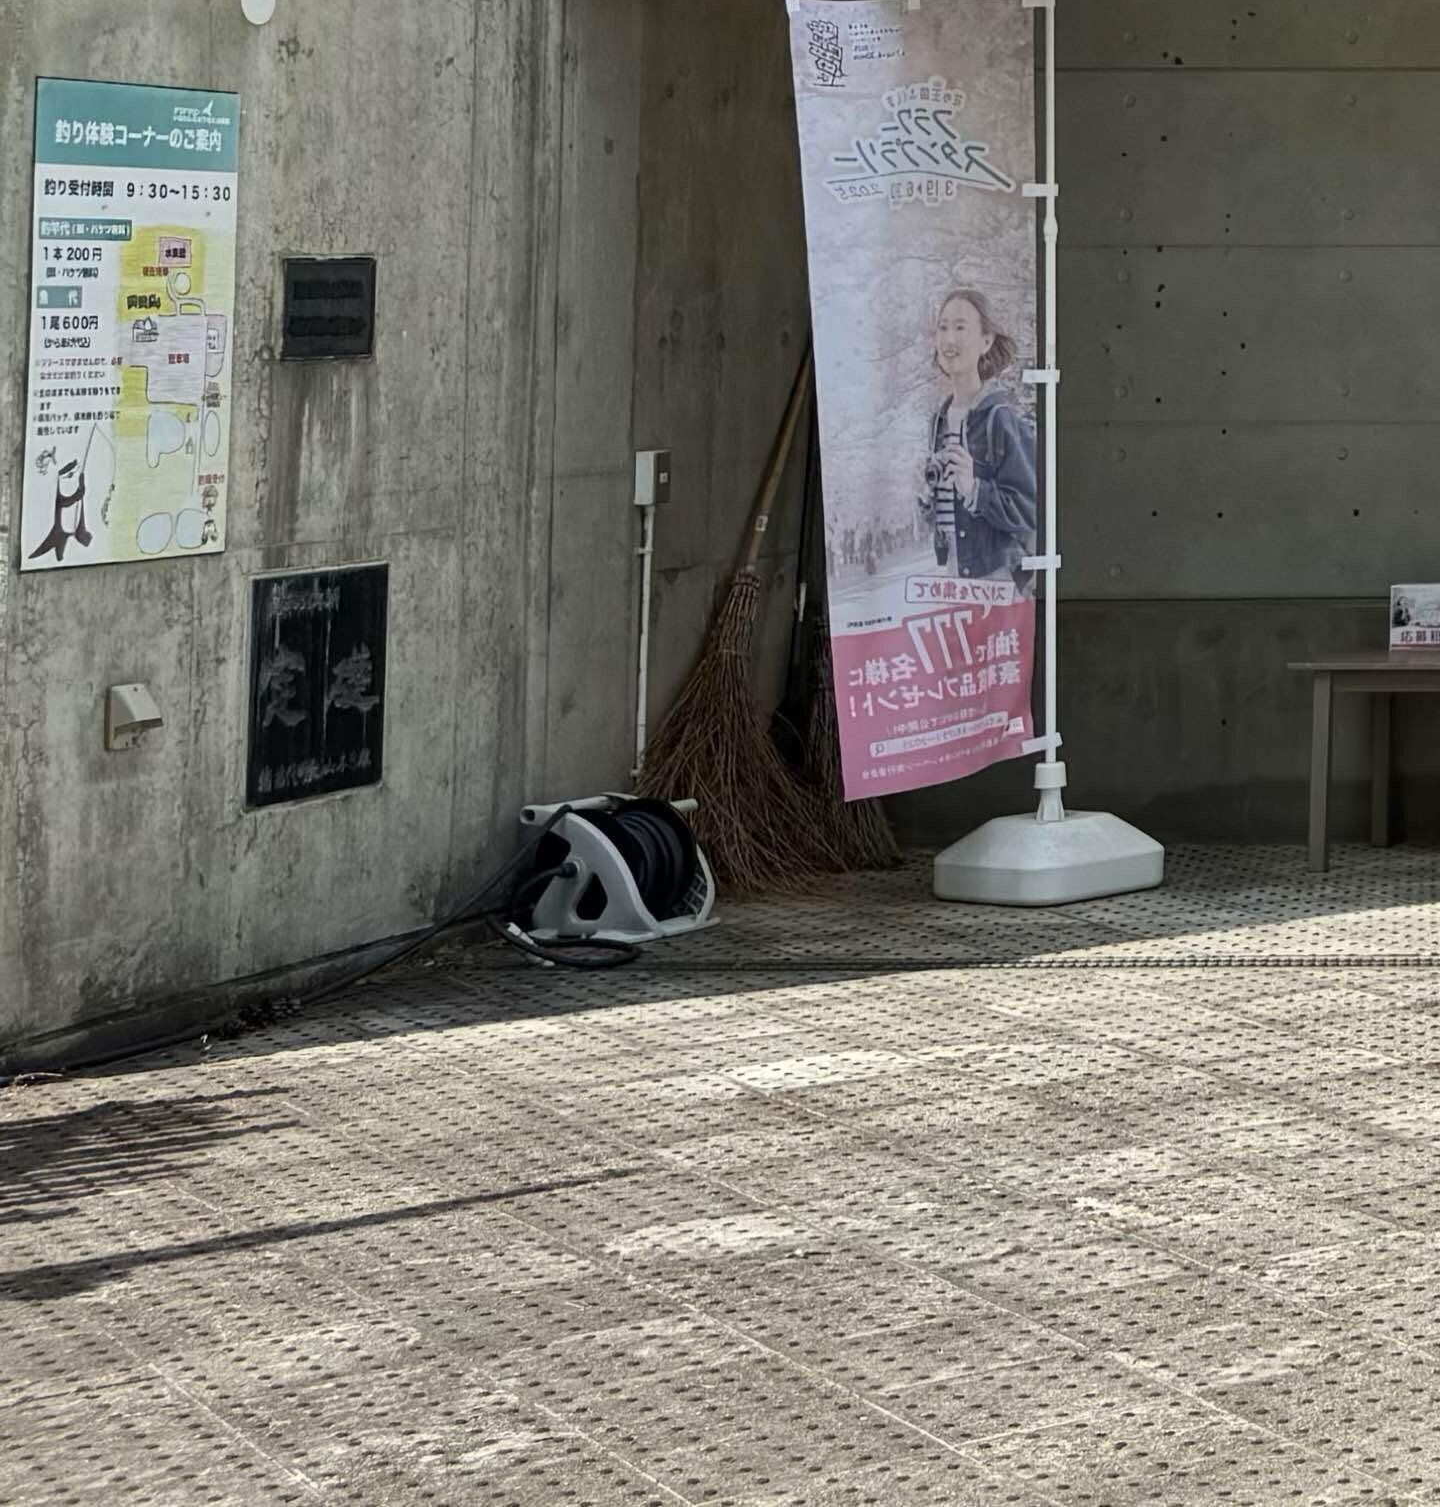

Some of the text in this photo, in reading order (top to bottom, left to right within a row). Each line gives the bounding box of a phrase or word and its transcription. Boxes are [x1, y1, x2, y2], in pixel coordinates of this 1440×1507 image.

[55, 118, 222, 152] 釣り体験コーナーのご案内
[44, 178, 114, 197] 釣り受付時間
